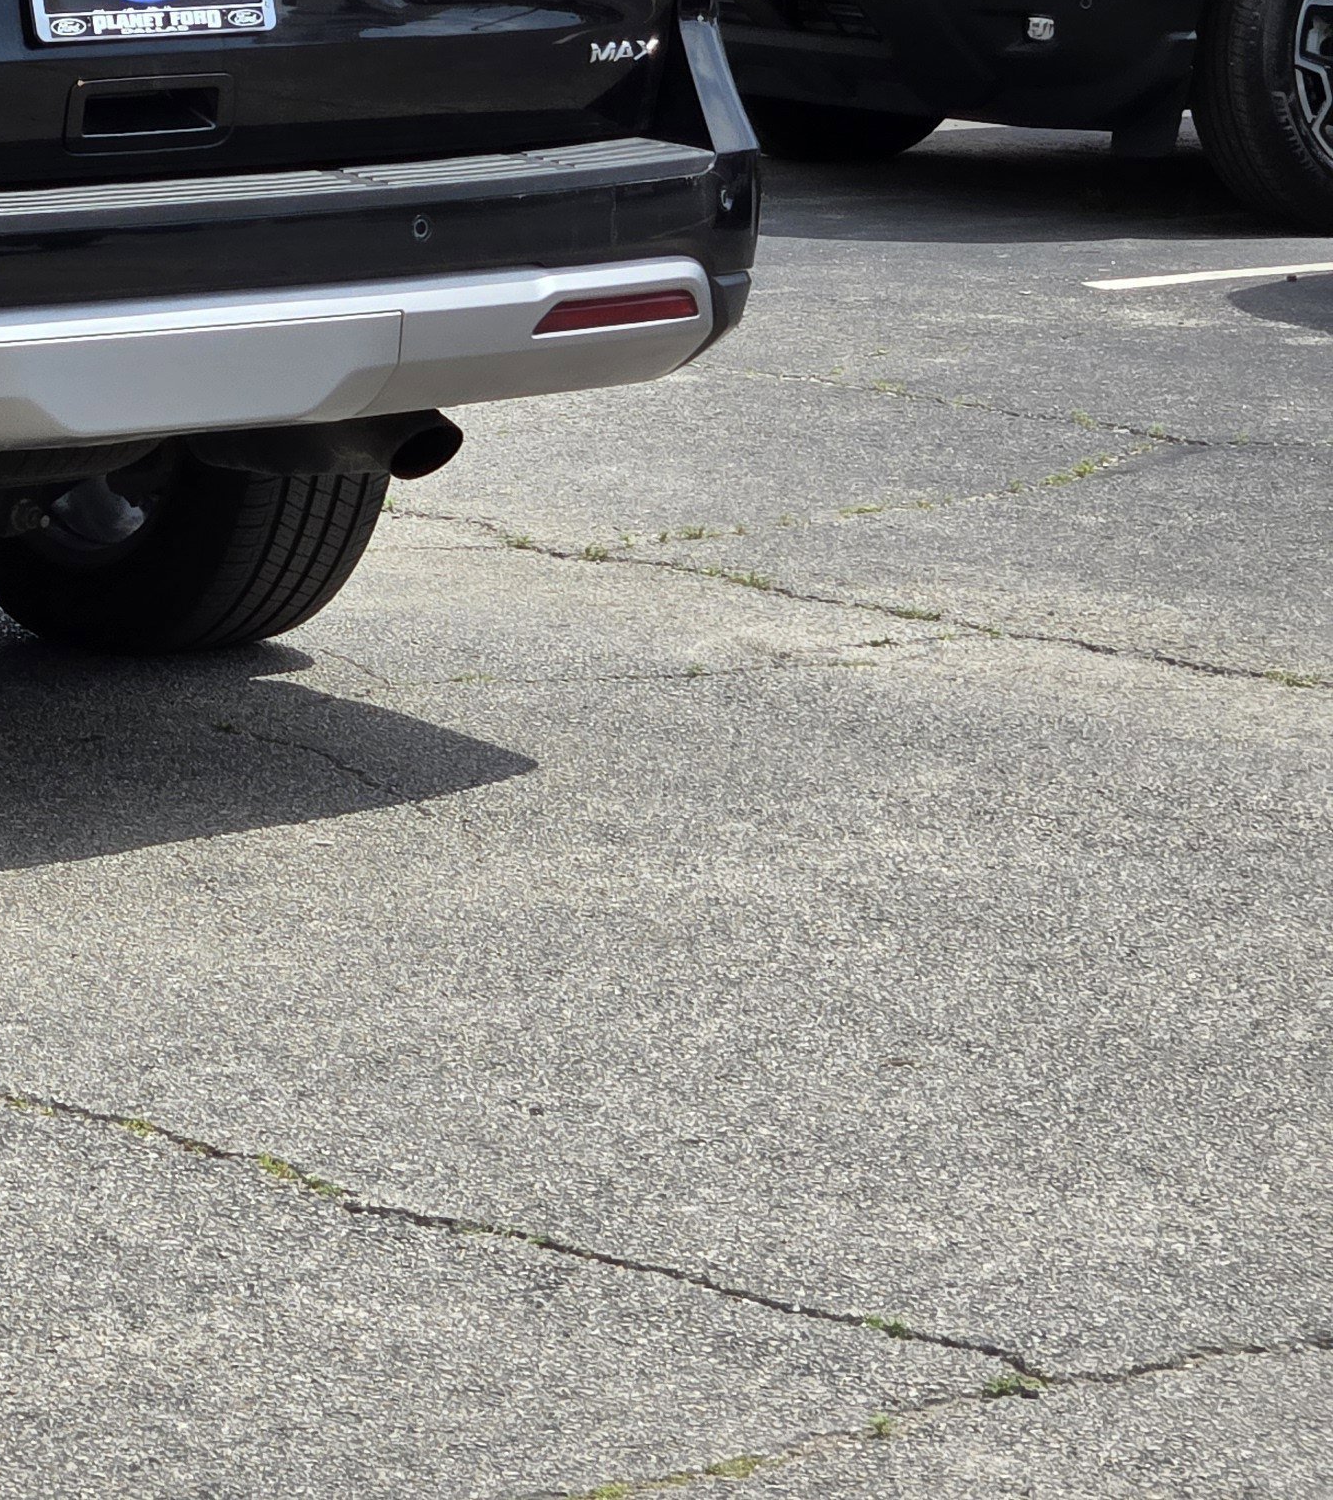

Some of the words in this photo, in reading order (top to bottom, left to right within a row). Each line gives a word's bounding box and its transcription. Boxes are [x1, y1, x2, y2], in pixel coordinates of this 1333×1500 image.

[93, 12, 164, 34] PLANET
[169, 9, 222, 28] FORD
[590, 37, 659, 63] MAX
